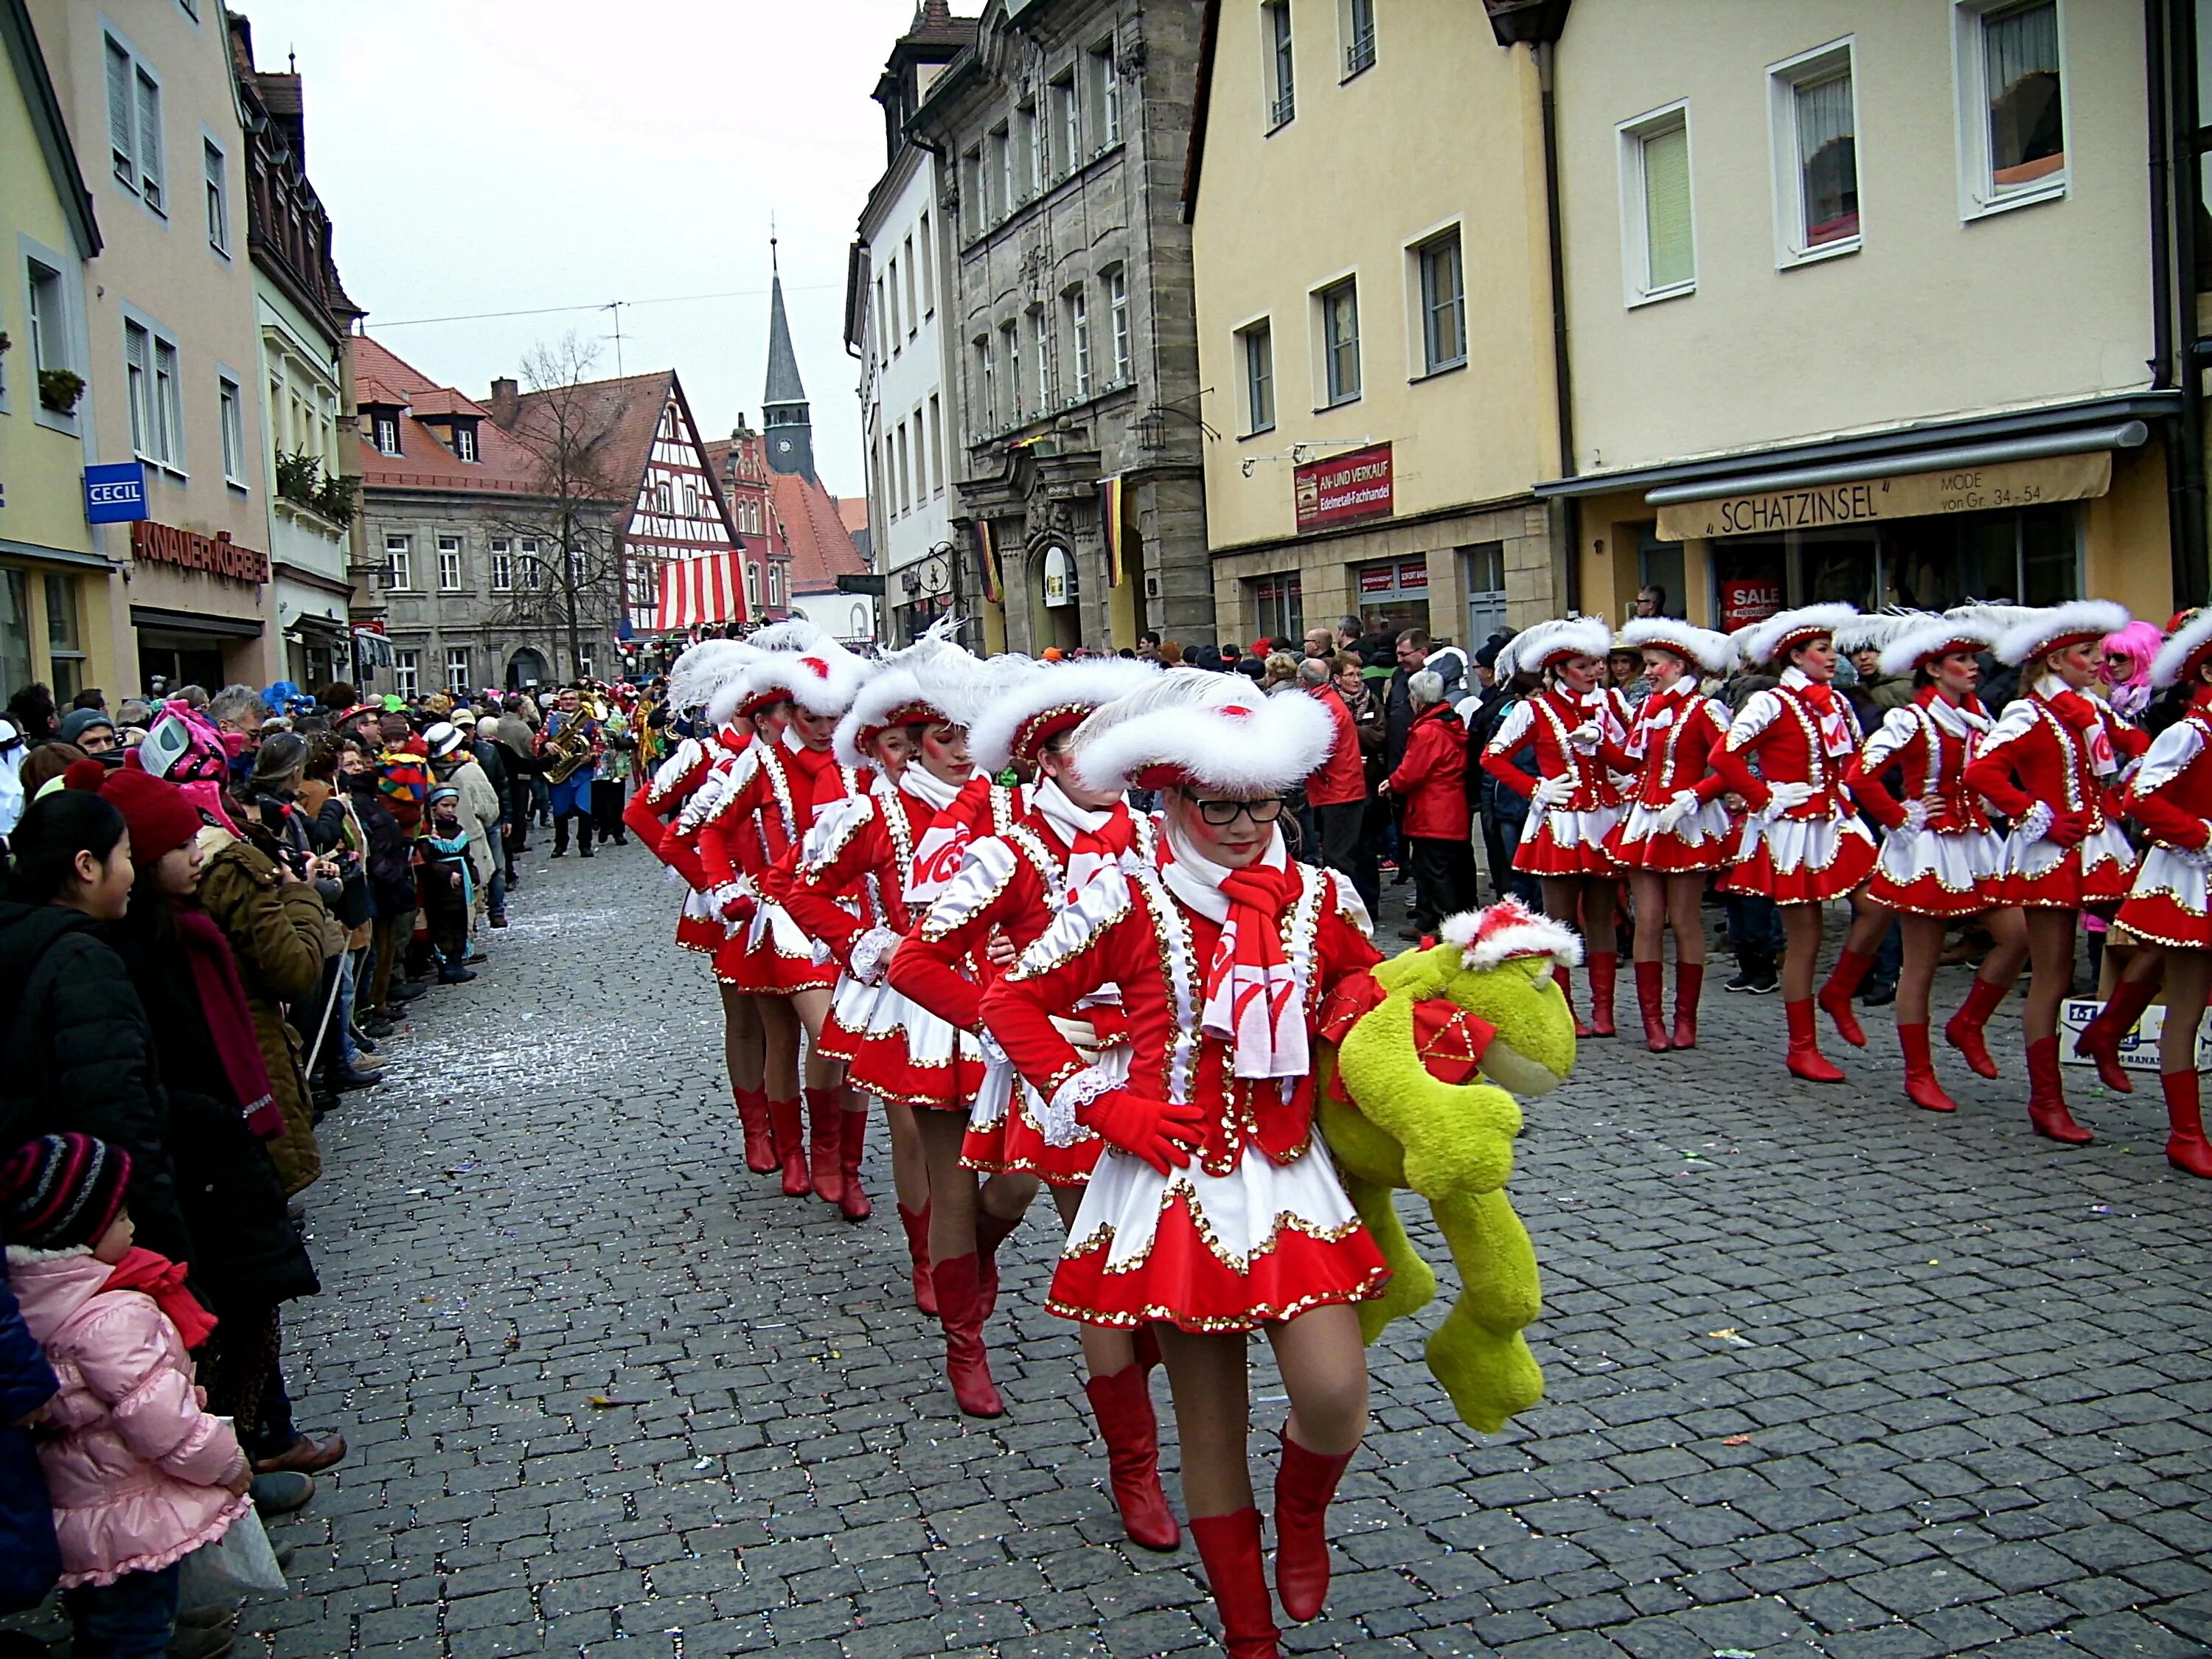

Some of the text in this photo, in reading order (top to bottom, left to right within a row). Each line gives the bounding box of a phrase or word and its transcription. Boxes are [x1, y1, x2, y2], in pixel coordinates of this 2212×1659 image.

[1320, 460, 1388, 491] AN- UND VERKAUF
[1941, 472, 1982, 492] MODE
[90, 485, 141, 501] CECIL
[1320, 484, 1390, 511] Edelmetall-Fachhandel
[1942, 499, 1964, 510] von
[1966, 492, 1986, 509] Gr.
[1994, 489, 2010, 505] 34
[2024, 485, 2040, 502] 54
[1722, 485, 1877, 533] SCHATZINSEL
[1733, 588, 1780, 605] SALE
